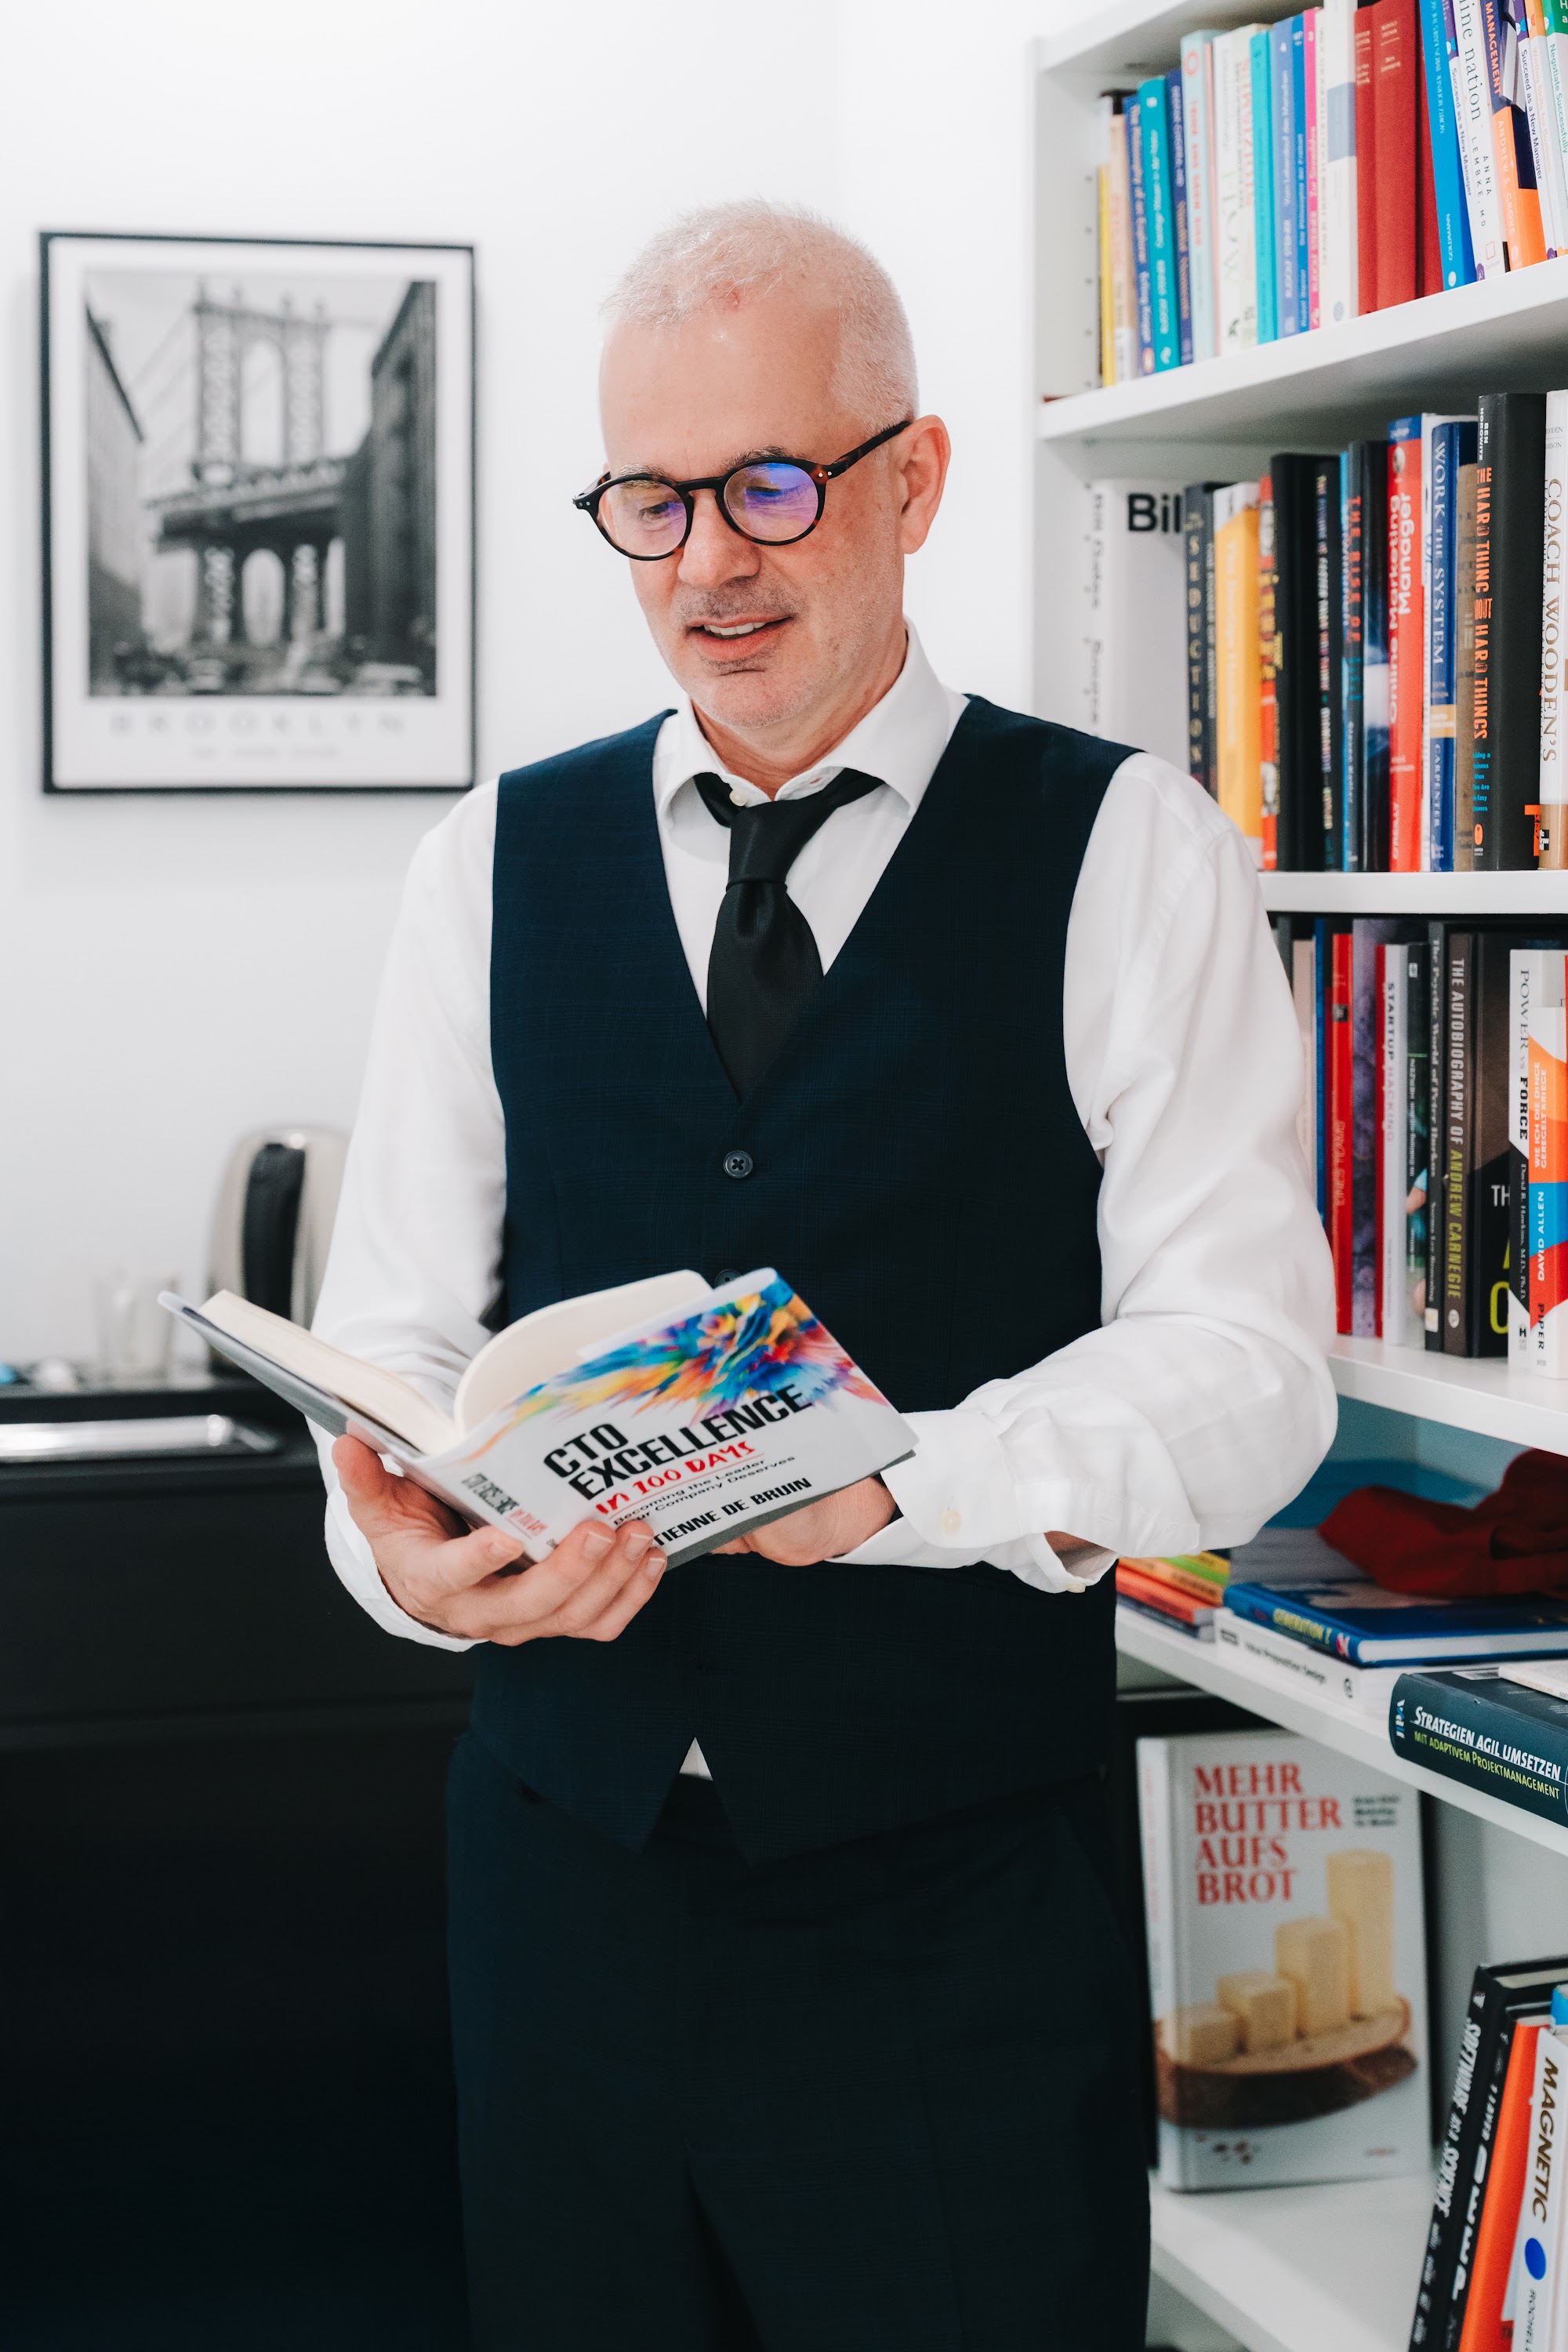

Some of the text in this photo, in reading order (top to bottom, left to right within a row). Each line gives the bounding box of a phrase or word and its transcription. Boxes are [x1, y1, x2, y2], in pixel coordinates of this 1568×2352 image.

[1485, 1, 1502, 95] MANAGEMENT
[1521, 49, 1532, 91] Succeed
[1465, 48, 1483, 123] nation
[1526, 93, 1534, 104] as
[1549, 43, 1568, 154] Negotiate Successfully
[1483, 155, 1493, 196] ANNA
[1497, 120, 1509, 172] ANDREW
[1504, 192, 1516, 234] GROVE
[1533, 136, 1543, 180] Manager
[1479, 209, 1486, 227] MD
[1347, 495, 1362, 537] THE
[1476, 487, 1491, 536] HARD
[1347, 550, 1362, 603] RISE
[1398, 492, 1414, 615] Manager
[1433, 441, 1446, 663] WORK THE SYSTEM
[1475, 539, 1490, 593] THING
[1347, 615, 1362, 643] OF
[1388, 495, 1400, 724] Online Marketing
[1543, 477, 1563, 762] COACH WOODEN'S
[1475, 624, 1489, 673] HARD
[1474, 677, 1488, 739] THINGS
[1386, 982, 1395, 1061] STARTUP
[1430, 967, 1440, 1020] Psychic
[1519, 970, 1530, 1051] POWER
[1431, 1023, 1439, 1065] World
[1430, 1087, 1439, 1125] Peter
[1431, 1068, 1439, 1085] of
[1448, 958, 1465, 1299] THE AUTOBIOGRAPHY OF ANDREW CARNEGIE
[1519, 1076, 1529, 1140] FORCE
[543, 1423, 629, 1478] CTO
[568, 1383, 813, 1501] EXCELLENCE
[632, 1468, 681, 1495] 100
[684, 1440, 756, 1474] DAYS
[613, 1459, 765, 1526] Becoming the Leader
[653, 1477, 812, 1547] TIENNE DE BRUIN
[655, 1456, 796, 1512] Company Deserves
[1414, 1705, 1562, 1781] STRATEGIEN AGIL UMSETZEN
[1414, 1730, 1560, 1800] MIT ADAPTIVEM PROJEKTMANAGEMENT
[1194, 1762, 1303, 1798] MEHR
[1195, 1797, 1342, 1835] BUTTER
[1194, 1835, 1288, 1870] AUFS
[1197, 1868, 1298, 1905] BROT
[1452, 2021, 1482, 2116] SOFTWARE
[1532, 2056, 1559, 2224] MAGNETIC
[1435, 2144, 1460, 2218] SCIENCE
[1452, 2143, 1488, 2302] DEEP
